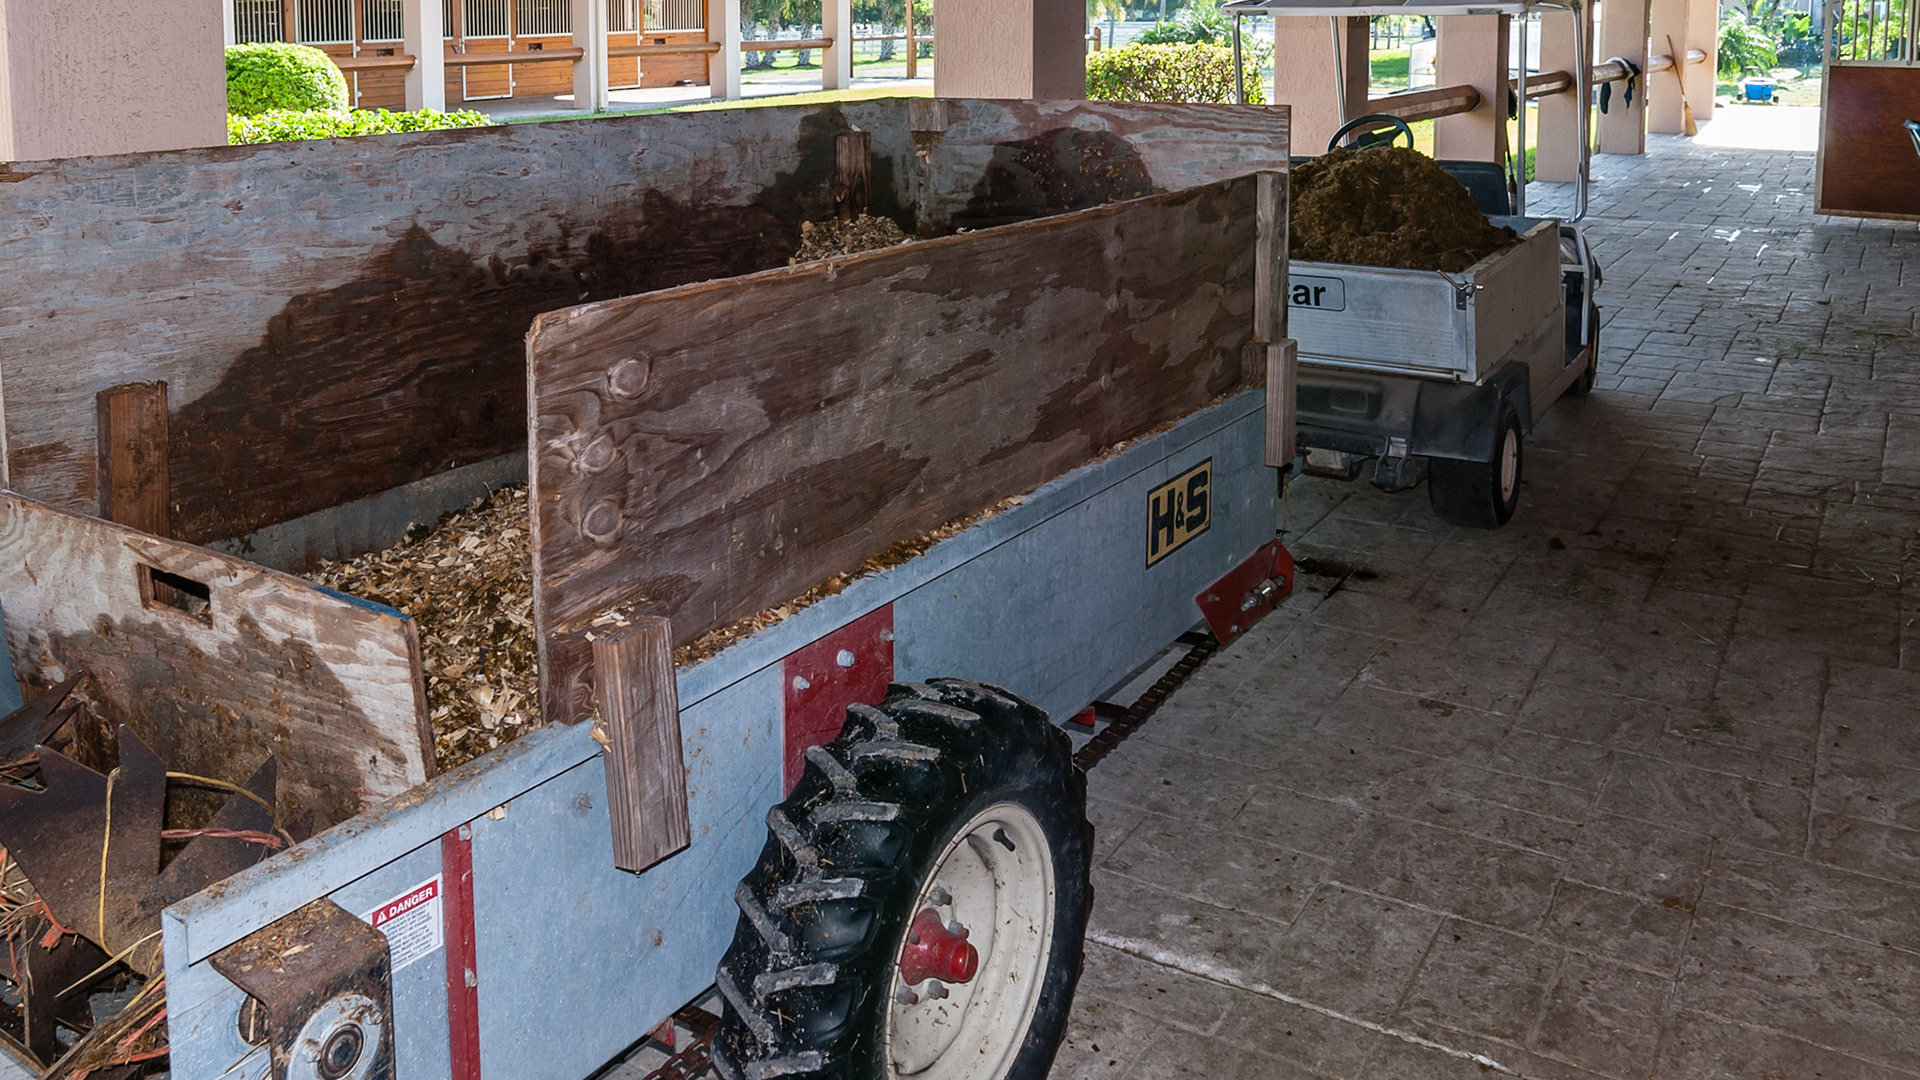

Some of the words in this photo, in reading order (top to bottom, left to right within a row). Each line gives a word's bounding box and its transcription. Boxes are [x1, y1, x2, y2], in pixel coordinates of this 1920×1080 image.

[1288, 283, 1326, 306] ar
[1150, 470, 1208, 557] H&S
[389, 887, 433, 918] DANGER
